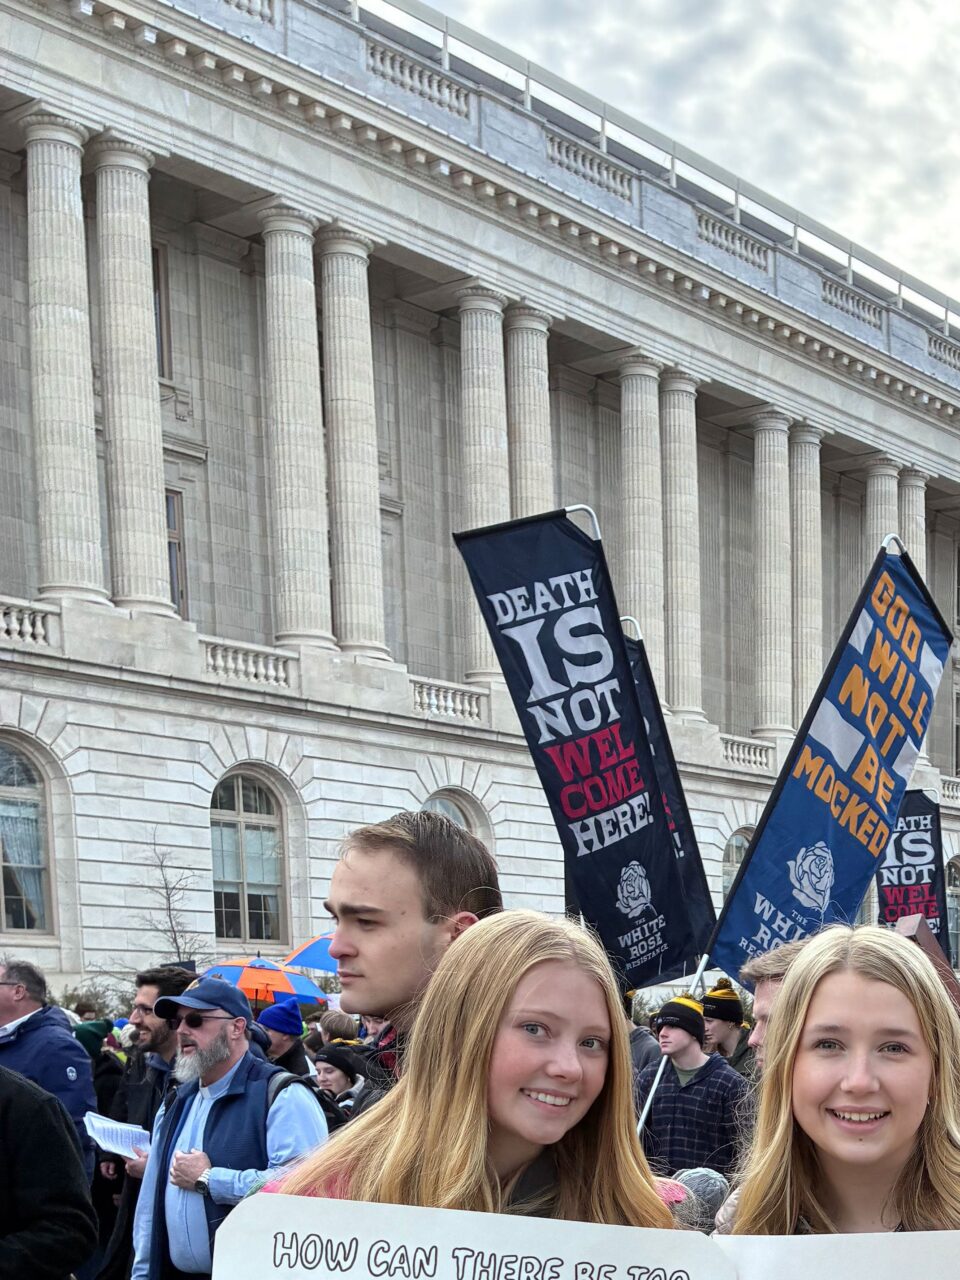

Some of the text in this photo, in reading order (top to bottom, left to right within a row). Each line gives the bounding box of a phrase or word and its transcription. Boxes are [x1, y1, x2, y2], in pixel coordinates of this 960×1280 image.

[486, 568, 598, 626] DEATH
[871, 570, 922, 664] GOD
[502, 605, 614, 702] IS
[868, 628, 929, 738] WILL
[526, 678, 621, 744] NOT
[838, 664, 905, 757] NOT
[544, 722, 635, 782] WEL
[560, 758, 645, 820] COME
[792, 744, 892, 858] MOCKED
[852, 743, 896, 814] BE
[567, 791, 654, 858] HERE!
[894, 814, 932, 832] ATH
[880, 831, 936, 868] IS
[880, 864, 936, 886] NOT
[883, 884, 937, 904] WEL
[618, 914, 666, 948] WHITE
[635, 917, 646, 925] THE
[753, 892, 813, 942] WHI
[791, 909, 808, 926] THE
[885, 902, 939, 922] COME
[626, 942, 669, 971] RESISTANCE
[629, 932, 662, 960] ROSE
[272, 1232, 358, 1274] HOW
[368, 1240, 438, 1278] CAN
